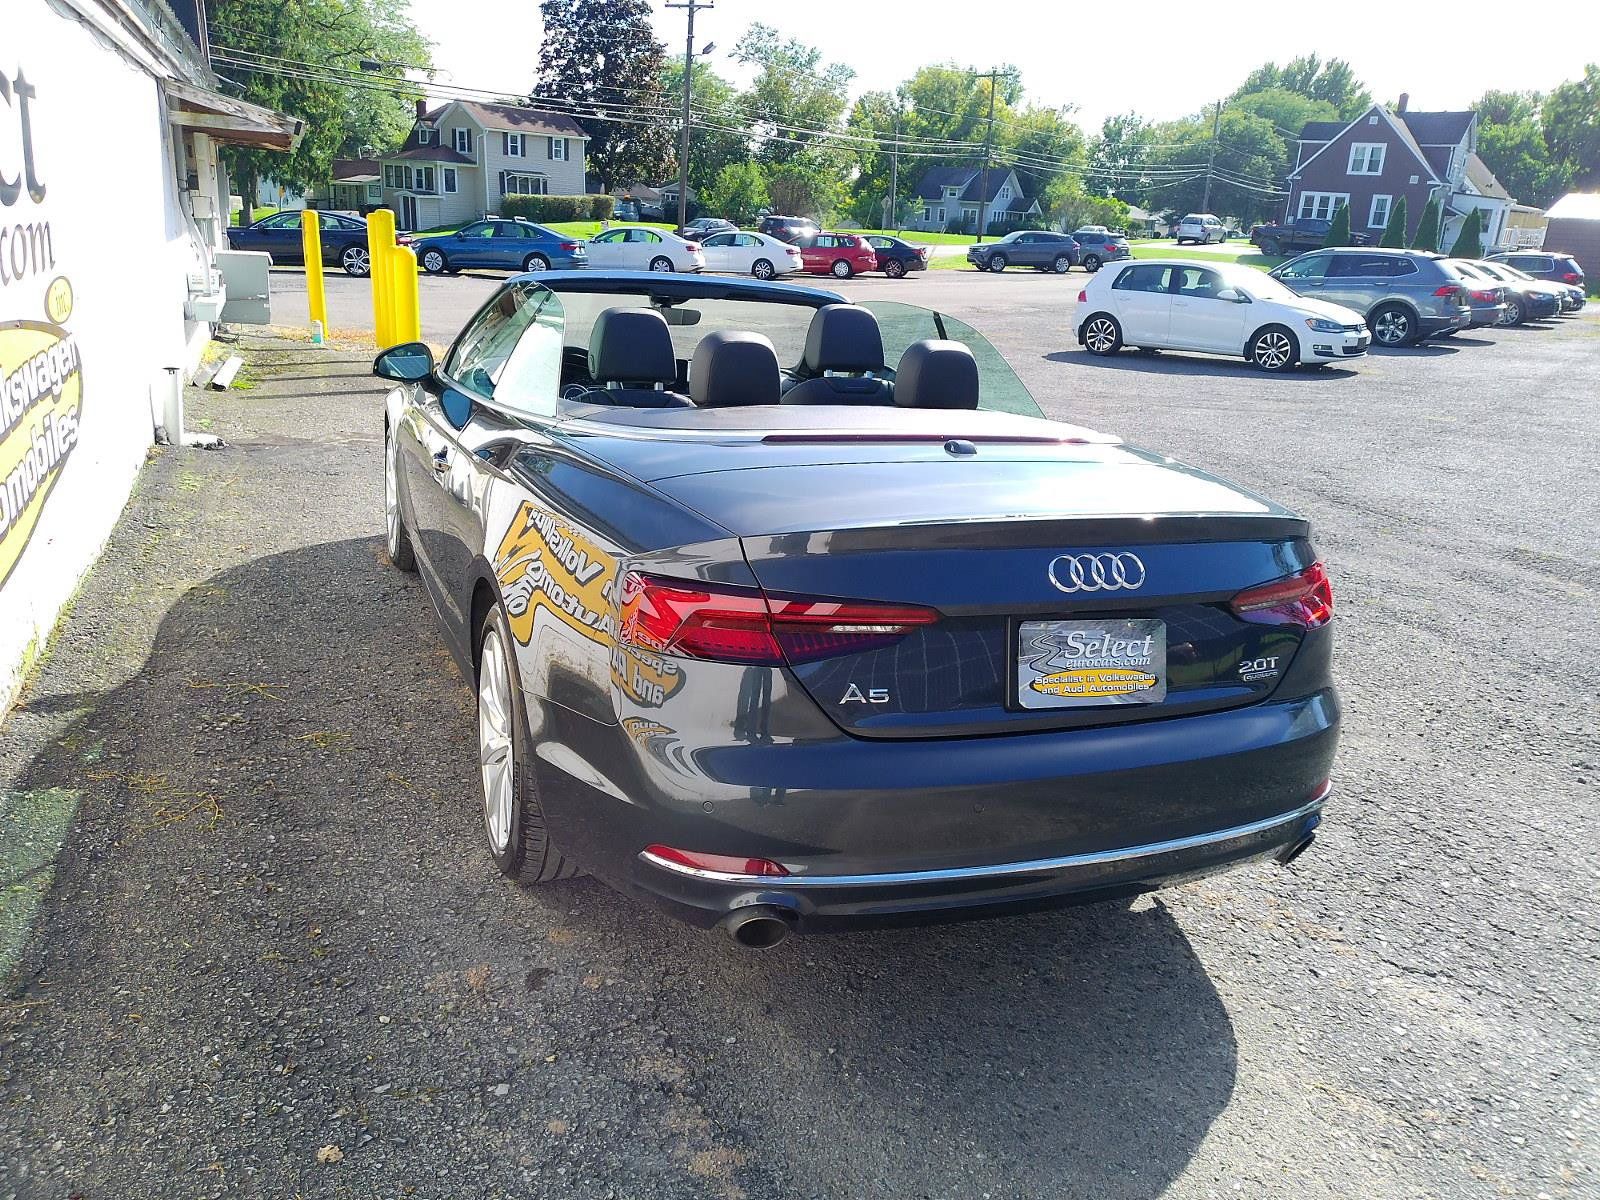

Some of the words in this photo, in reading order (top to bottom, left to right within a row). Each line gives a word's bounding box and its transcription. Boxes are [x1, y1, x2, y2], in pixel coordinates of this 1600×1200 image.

[1064, 631, 1155, 659] Select
[1034, 675, 1084, 685] Specialist
[1087, 674, 1096, 682] in
[1098, 673, 1156, 683] Volkswagen
[839, 682, 890, 704] A5
[1041, 685, 1060, 695] and
[1063, 684, 1085, 694] Audi
[1088, 683, 1150, 693] Automobiles
